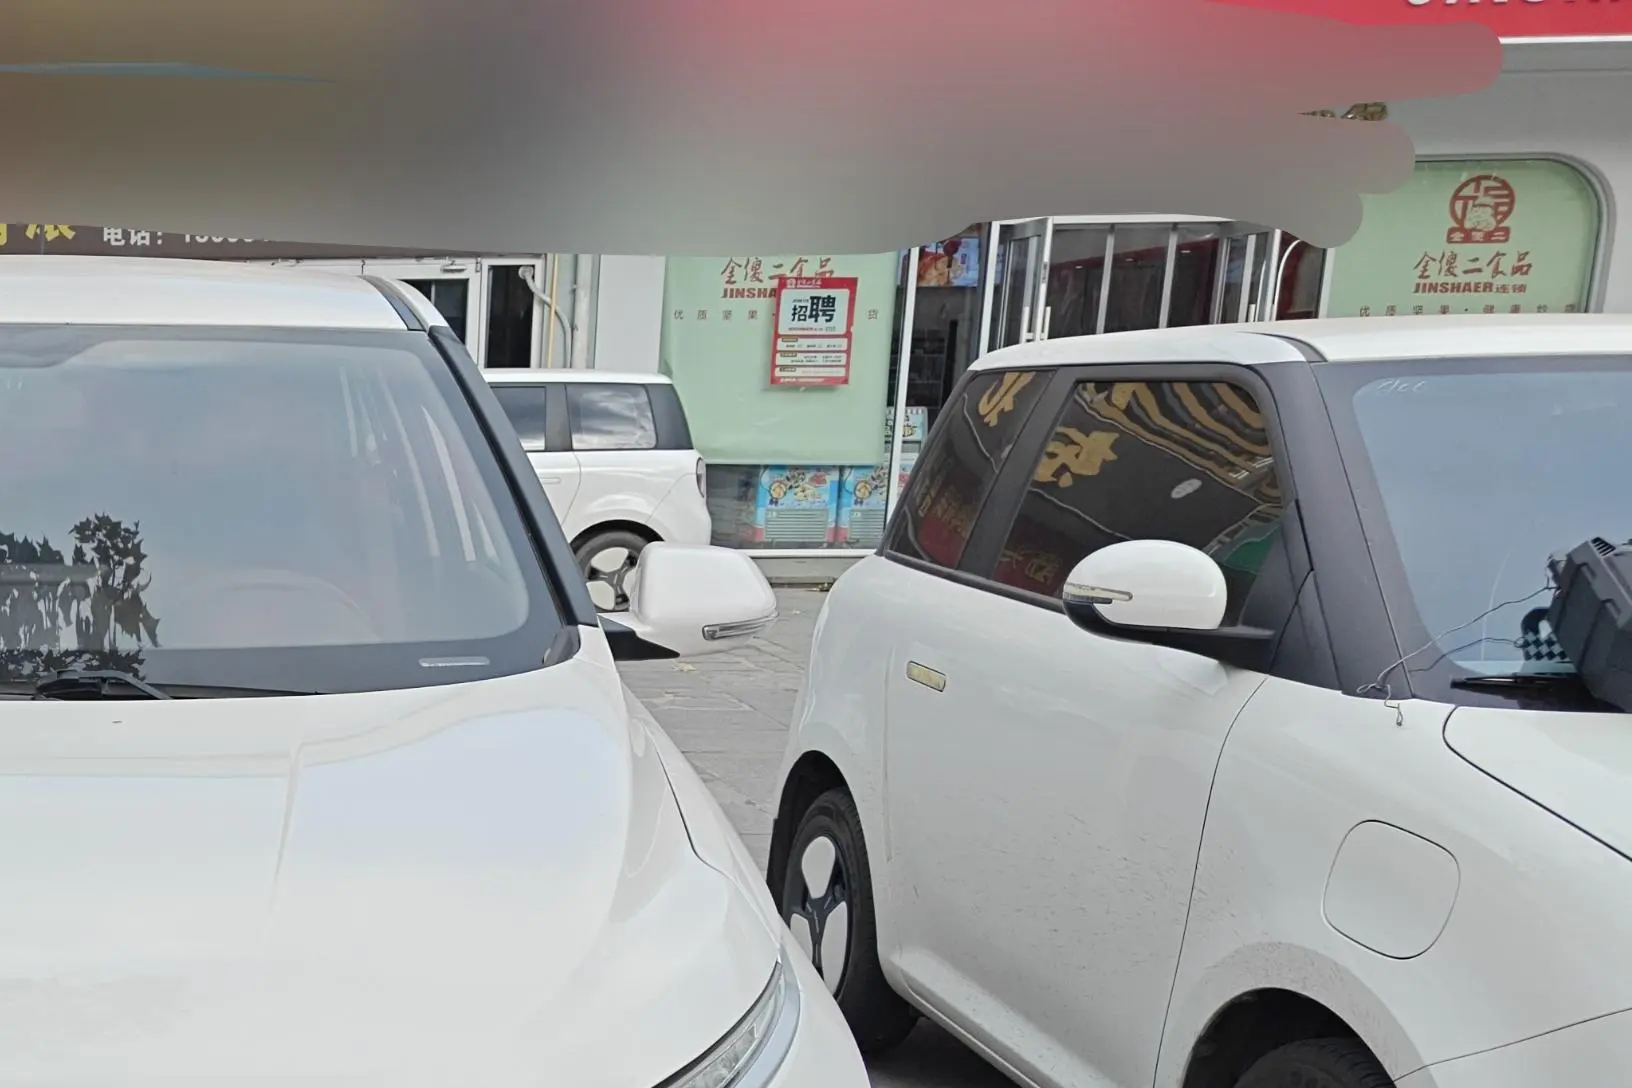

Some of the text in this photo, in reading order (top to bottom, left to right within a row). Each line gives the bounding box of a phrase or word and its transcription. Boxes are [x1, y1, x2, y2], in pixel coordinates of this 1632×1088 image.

[1413, 251, 1532, 279] 金傻二食品
[1413, 282, 1493, 293] JINSHAER
[791, 295, 836, 322] 招聘
